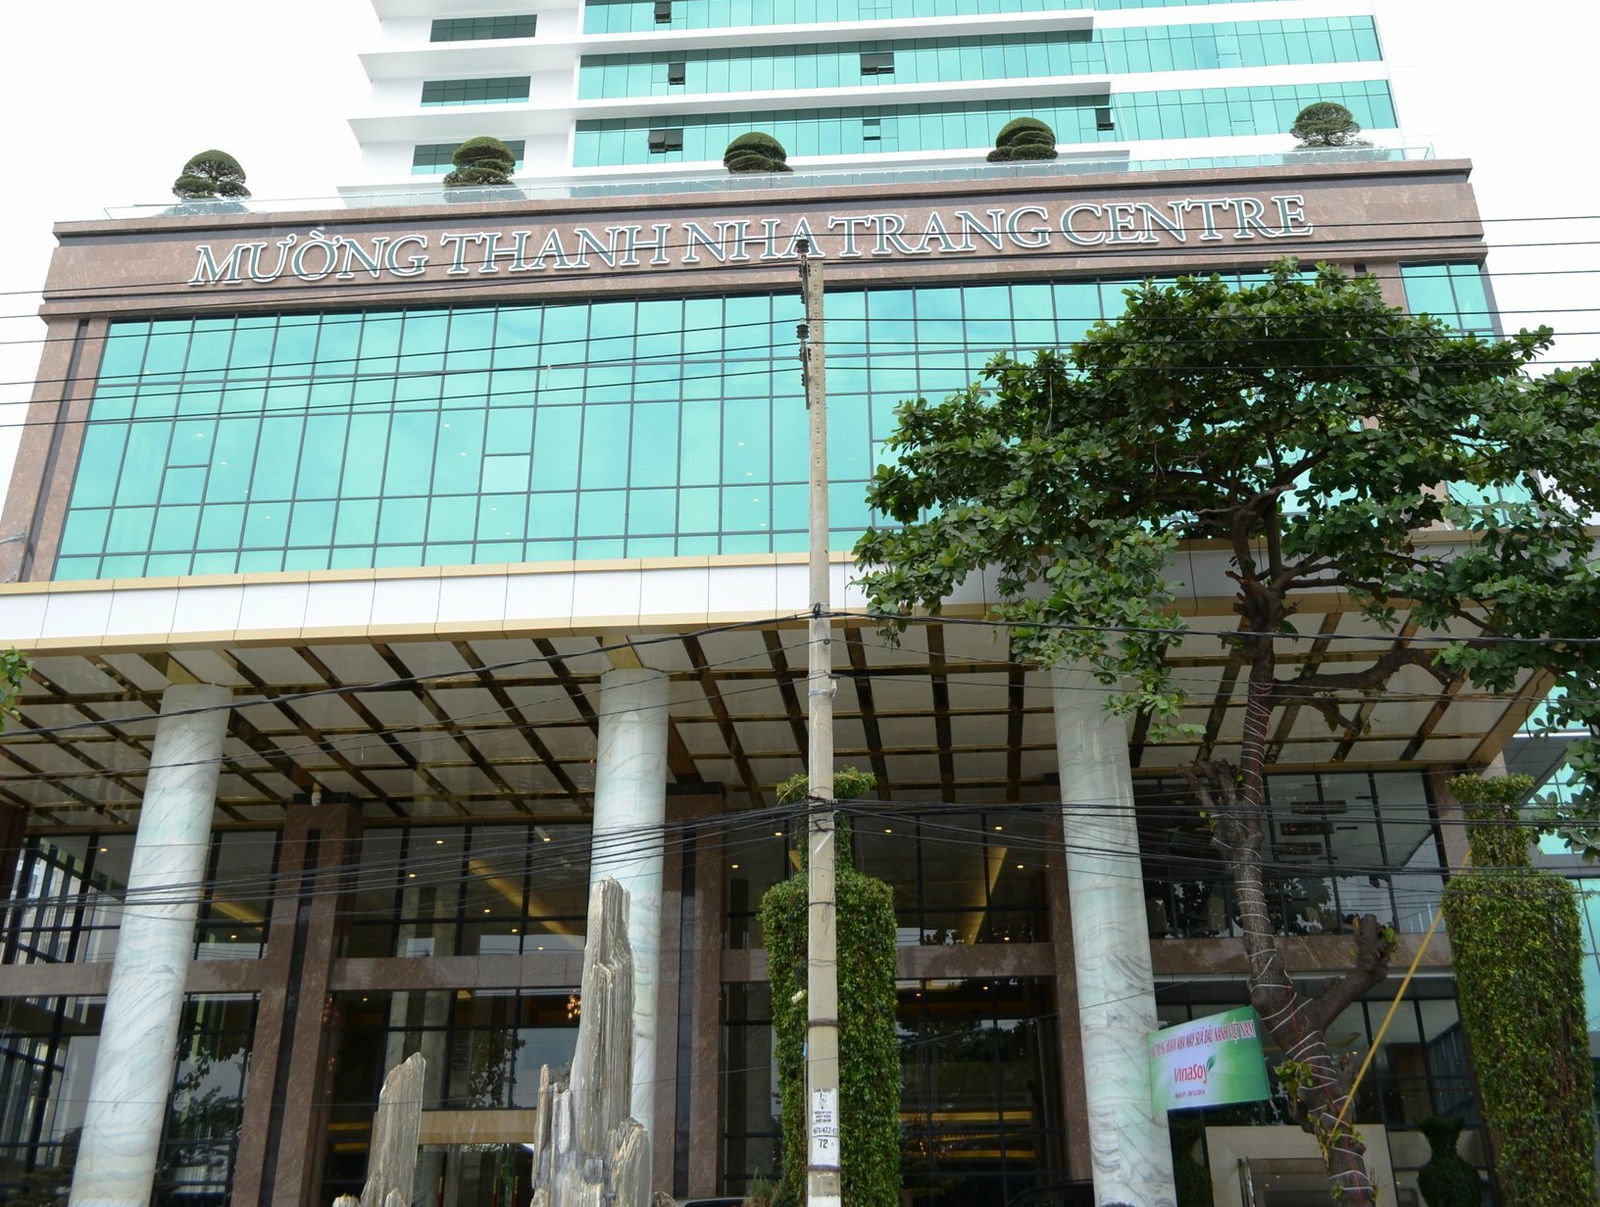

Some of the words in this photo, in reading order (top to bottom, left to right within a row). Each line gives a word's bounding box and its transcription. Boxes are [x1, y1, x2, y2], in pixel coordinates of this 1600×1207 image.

[188, 226, 429, 287] MƯỜNG
[440, 223, 672, 276] THANH
[680, 212, 823, 264] NHA
[828, 205, 1050, 258] TRANG
[1059, 194, 1313, 248] CENTRE
[818, 1138, 828, 1148] 72
